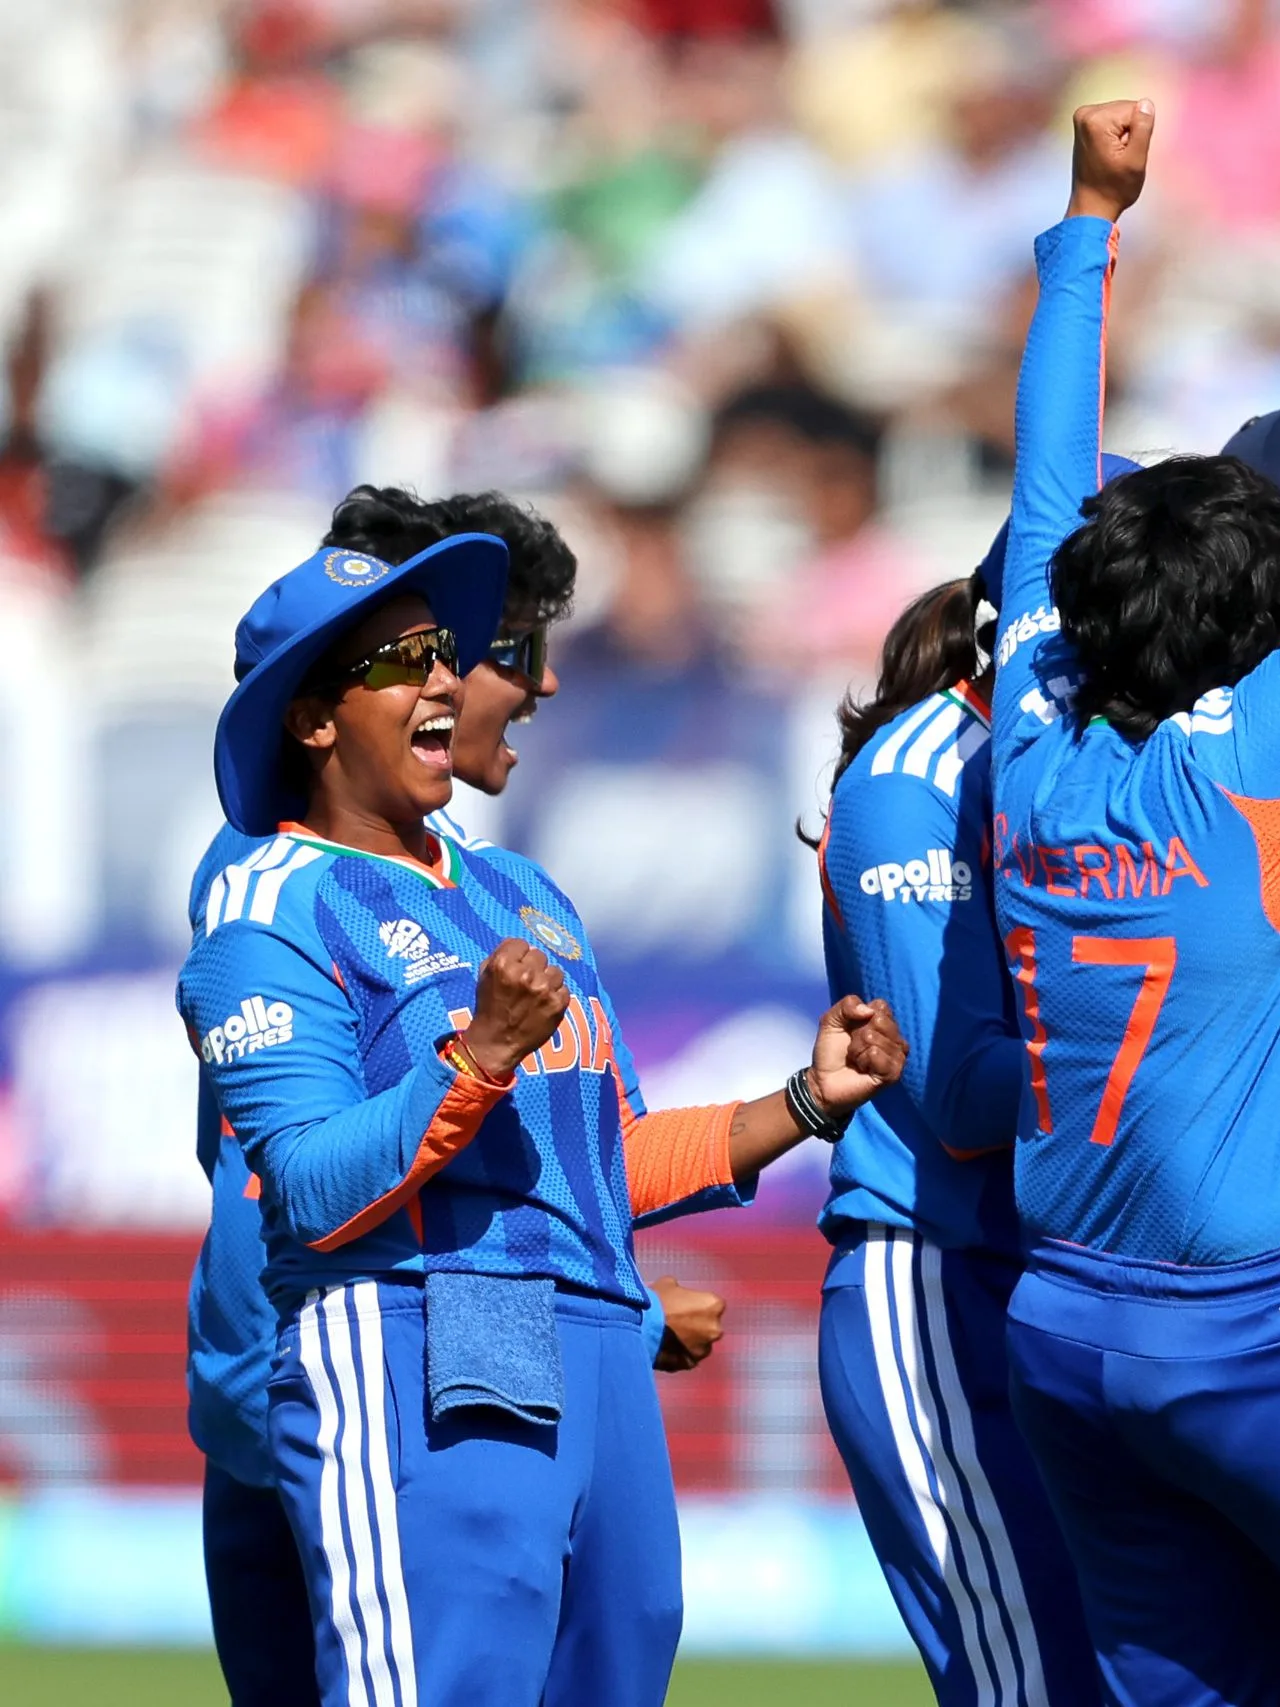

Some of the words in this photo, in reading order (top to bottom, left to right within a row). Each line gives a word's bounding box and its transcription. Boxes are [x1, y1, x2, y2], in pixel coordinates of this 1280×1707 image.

[860, 848, 972, 901] apollo
[899, 884, 972, 904] TYRES
[201, 995, 293, 1065] apollo
[225, 1023, 293, 1064] TYRES
[1004, 926, 1178, 1147] 17
